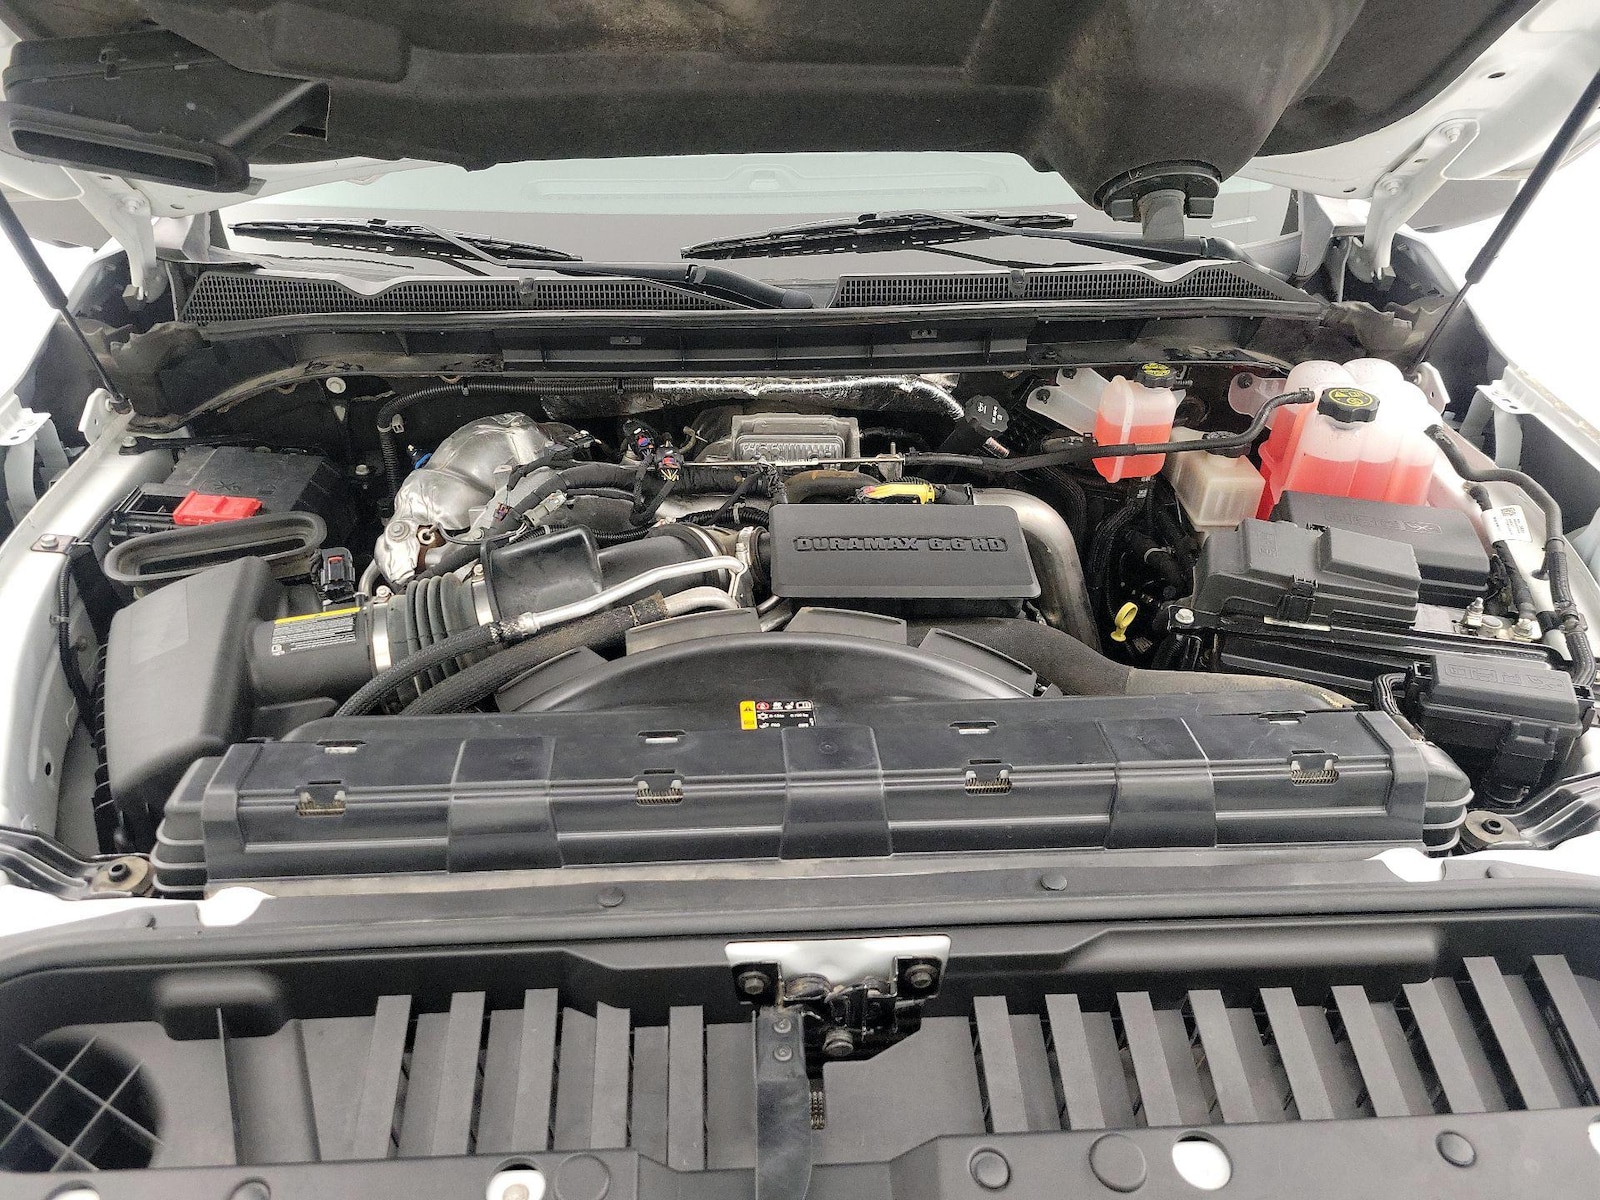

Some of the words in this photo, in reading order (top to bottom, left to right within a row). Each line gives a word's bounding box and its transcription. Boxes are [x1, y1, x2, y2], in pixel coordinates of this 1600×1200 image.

[796, 537, 918, 551] DURAMAX
[928, 537, 966, 551] 6.6
[971, 537, 1005, 551] HD
